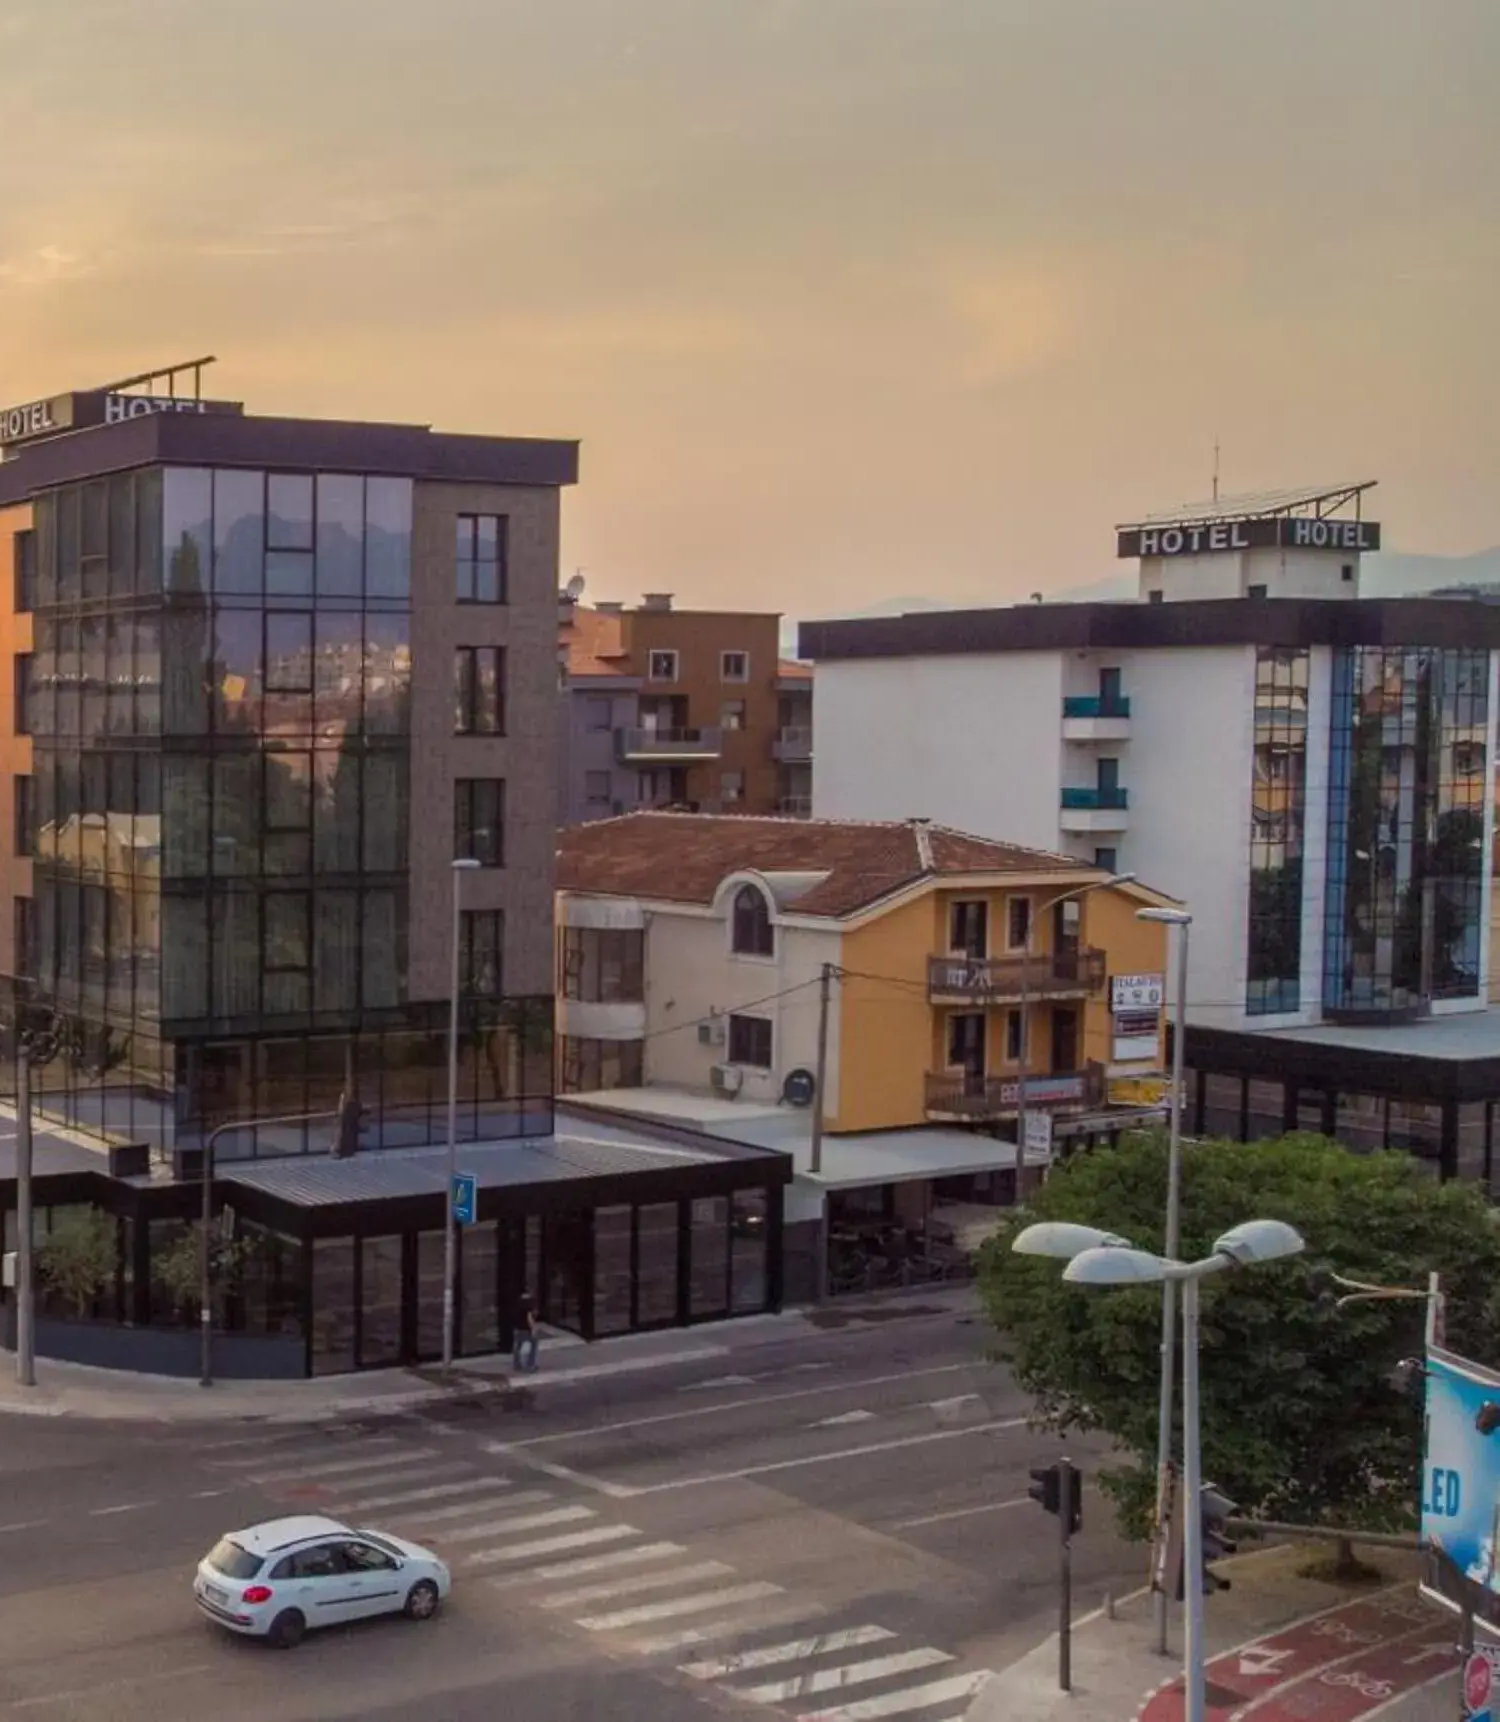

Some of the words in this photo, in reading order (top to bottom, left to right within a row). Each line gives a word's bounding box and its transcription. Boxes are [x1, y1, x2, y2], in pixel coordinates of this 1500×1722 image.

[105, 395, 206, 424] HOT
[1139, 523, 1250, 554] HOTEL
[1294, 521, 1370, 548] HOTEL
